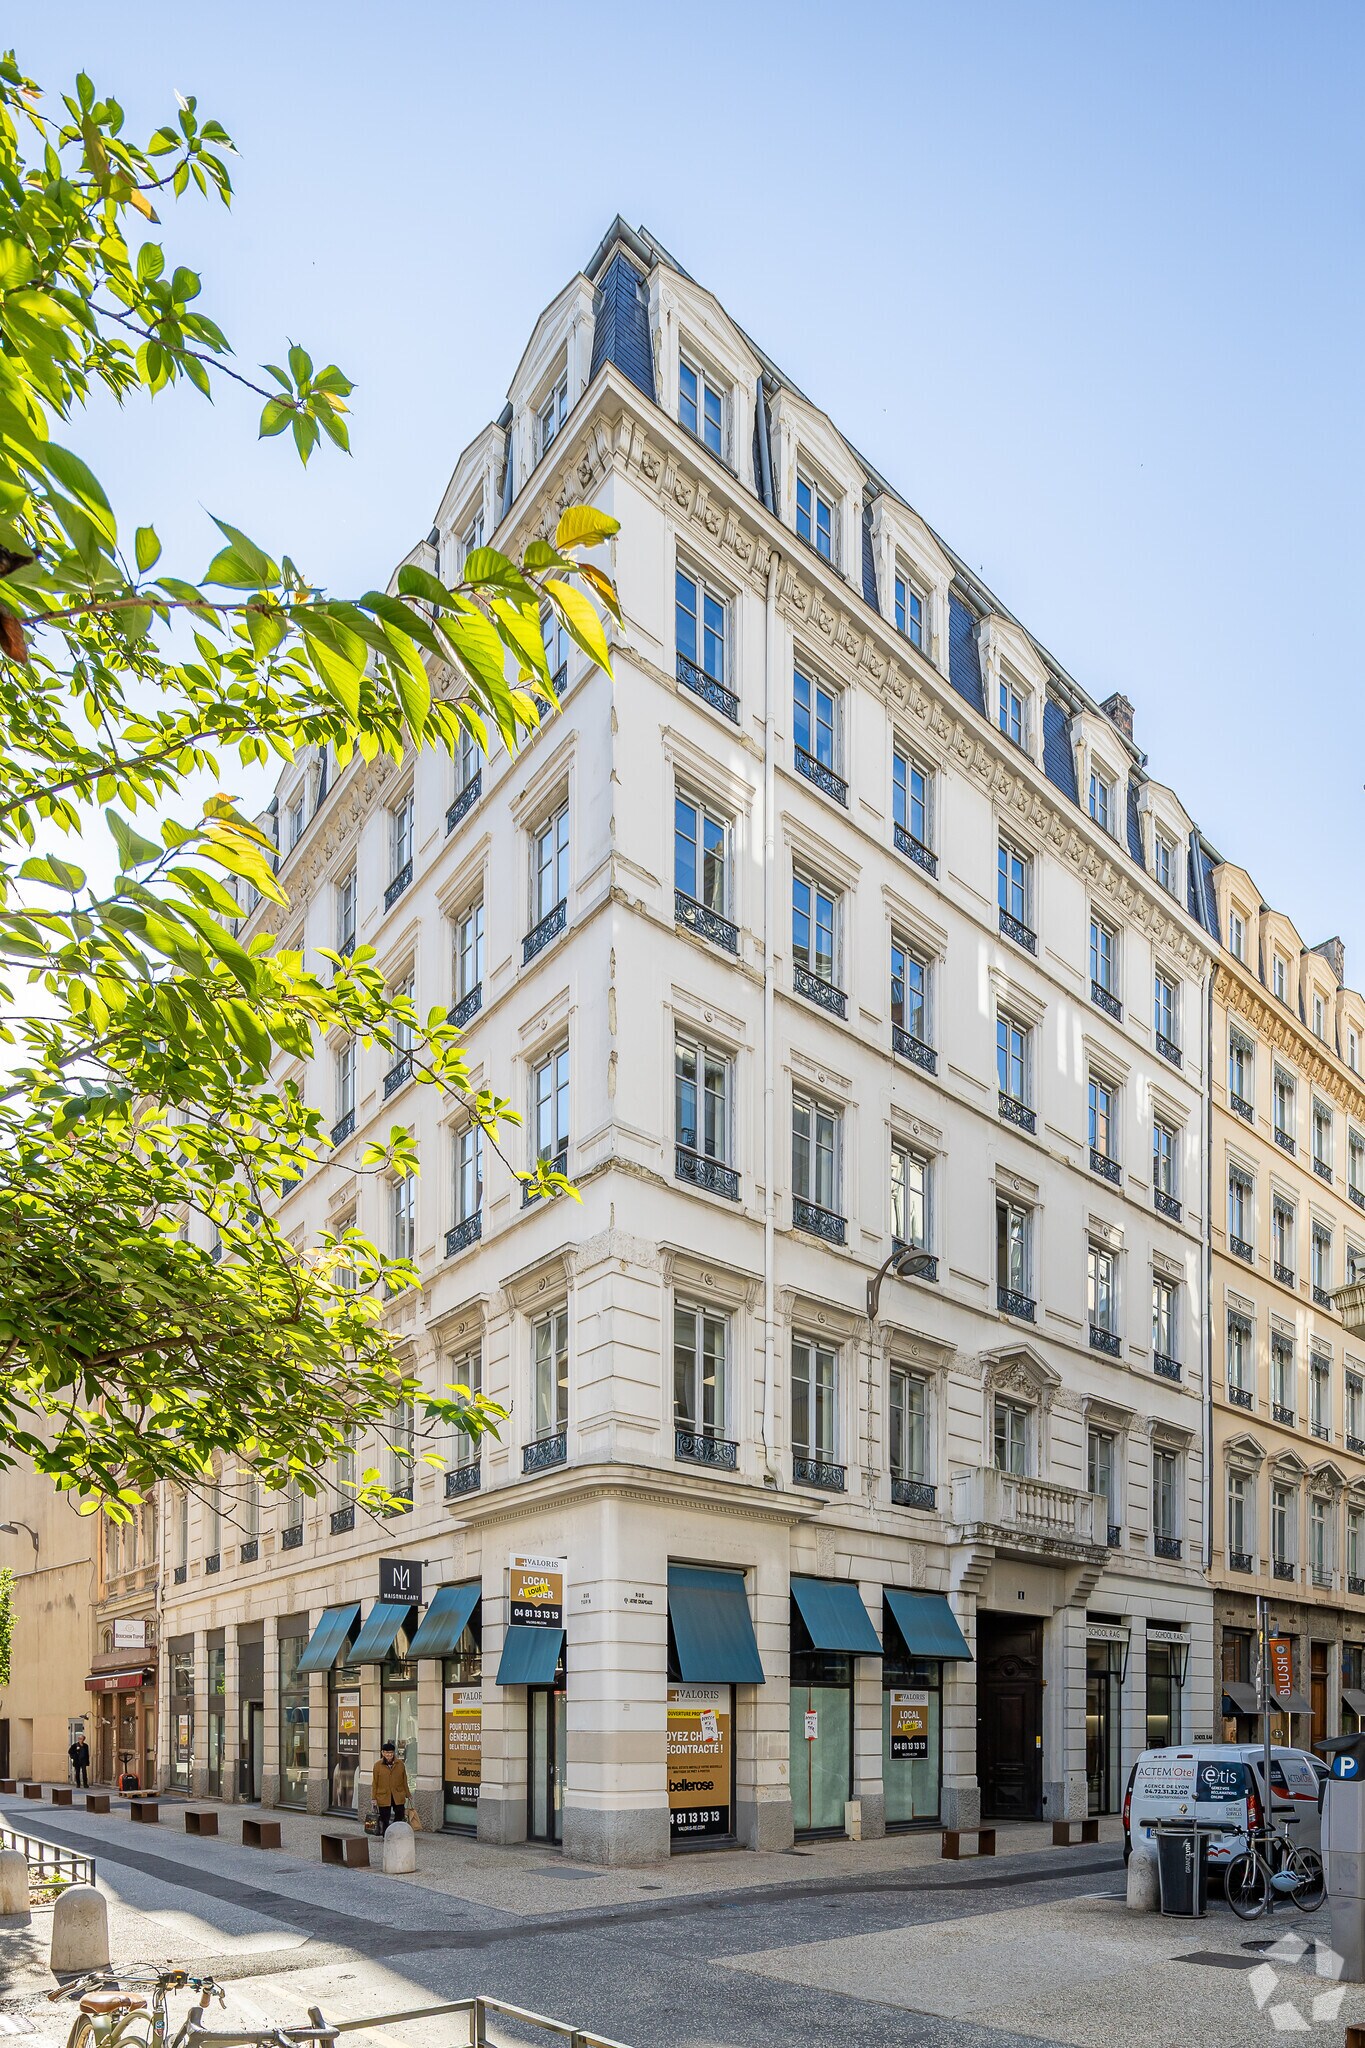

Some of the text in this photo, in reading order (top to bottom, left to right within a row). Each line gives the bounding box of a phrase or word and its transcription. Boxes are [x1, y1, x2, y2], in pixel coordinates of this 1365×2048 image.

[528, 1558, 558, 1568] VALORIS
[522, 1576, 550, 1586] LOCAL
[518, 1588, 524, 1596] A
[1088, 1628, 1108, 1637] SCHOOL
[1155, 1631, 1172, 1639] SCHOOL
[1277, 1657, 1290, 1695] BLUSH
[680, 1690, 719, 1699] VALORIS
[1340, 1757, 1355, 1776] P
[458, 1767, 480, 1777] bellerose
[1138, 1767, 1194, 1777] ACTEM'Otel
[669, 1779, 714, 1792] bellerose
[453, 1786, 459, 1794] 04
[467, 1787, 472, 1795] 13
[474, 1788, 479, 1796] 13
[677, 1814, 686, 1824] 81
[689, 1812, 697, 1823] 13
[700, 1812, 708, 1822] 13
[711, 1811, 719, 1821] 13
